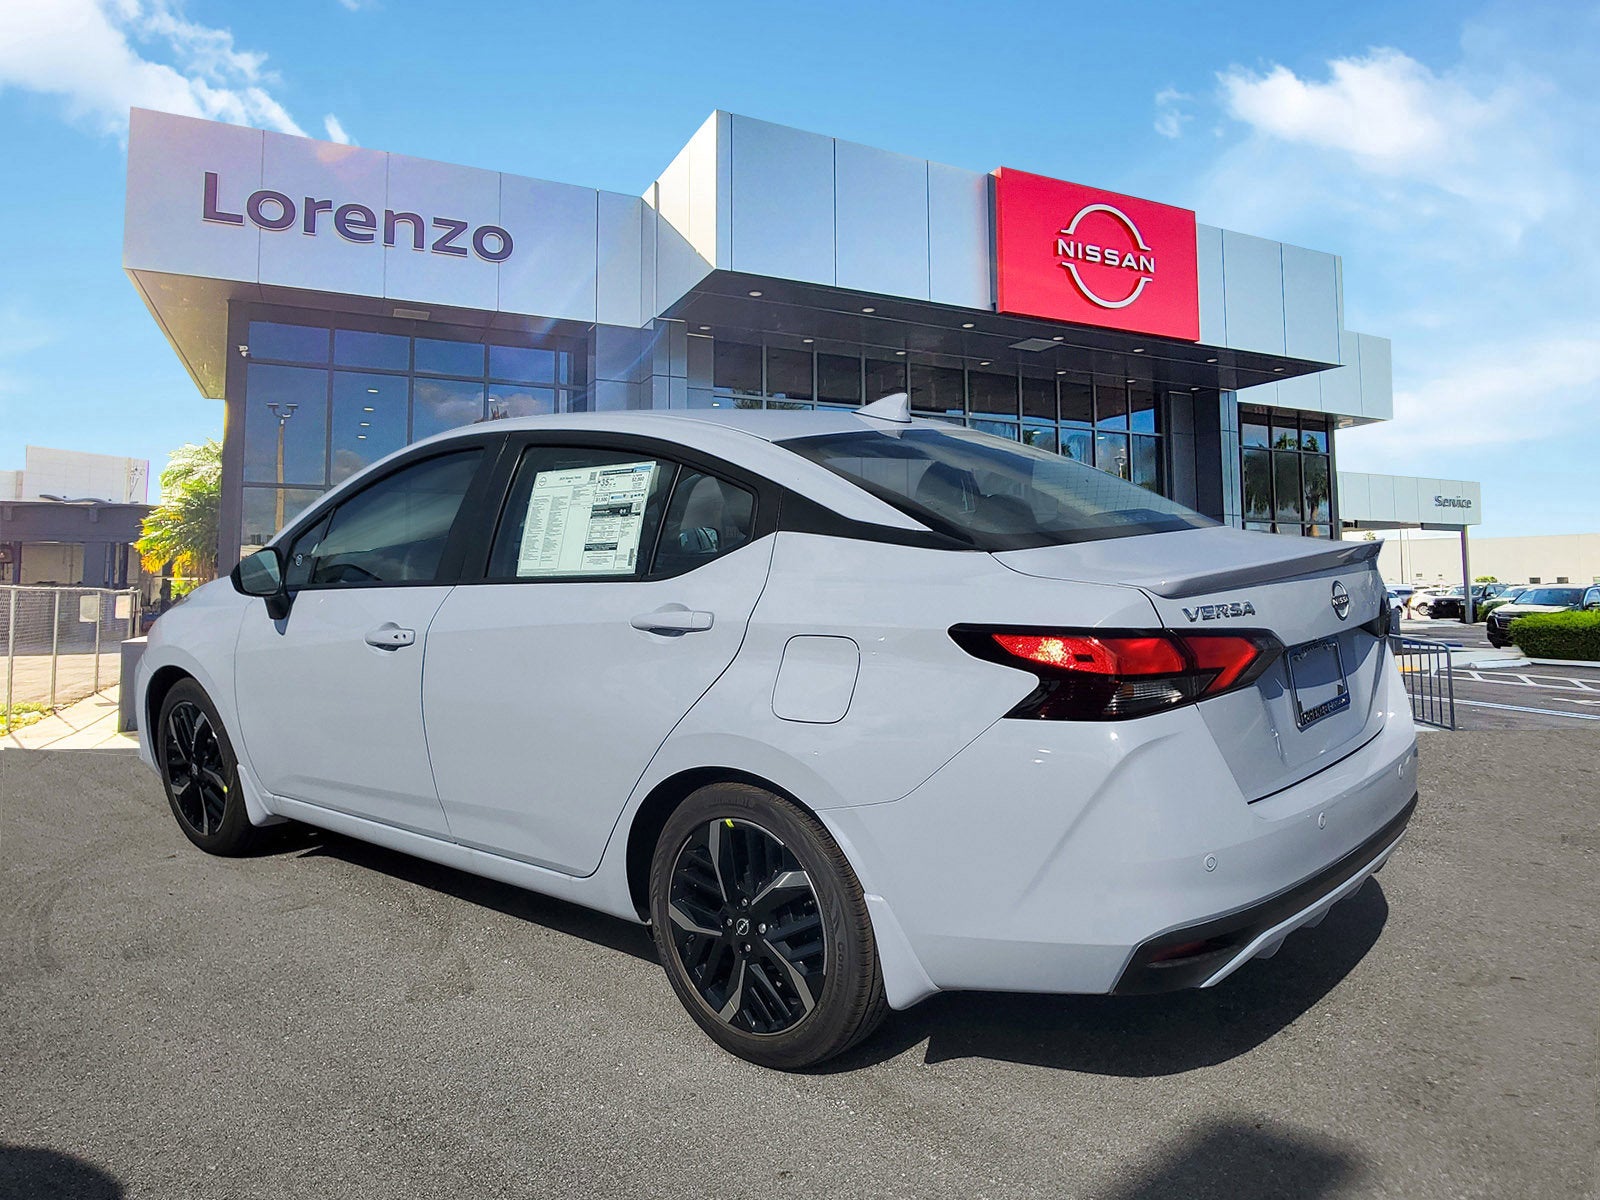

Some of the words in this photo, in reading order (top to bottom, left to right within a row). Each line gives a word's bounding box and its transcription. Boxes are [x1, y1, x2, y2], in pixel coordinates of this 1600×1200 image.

[202, 171, 514, 262] Lorenzo
[1057, 238, 1155, 273] NISSAN
[1434, 495, 1472, 508] Service
[1182, 601, 1256, 622] VERSA
